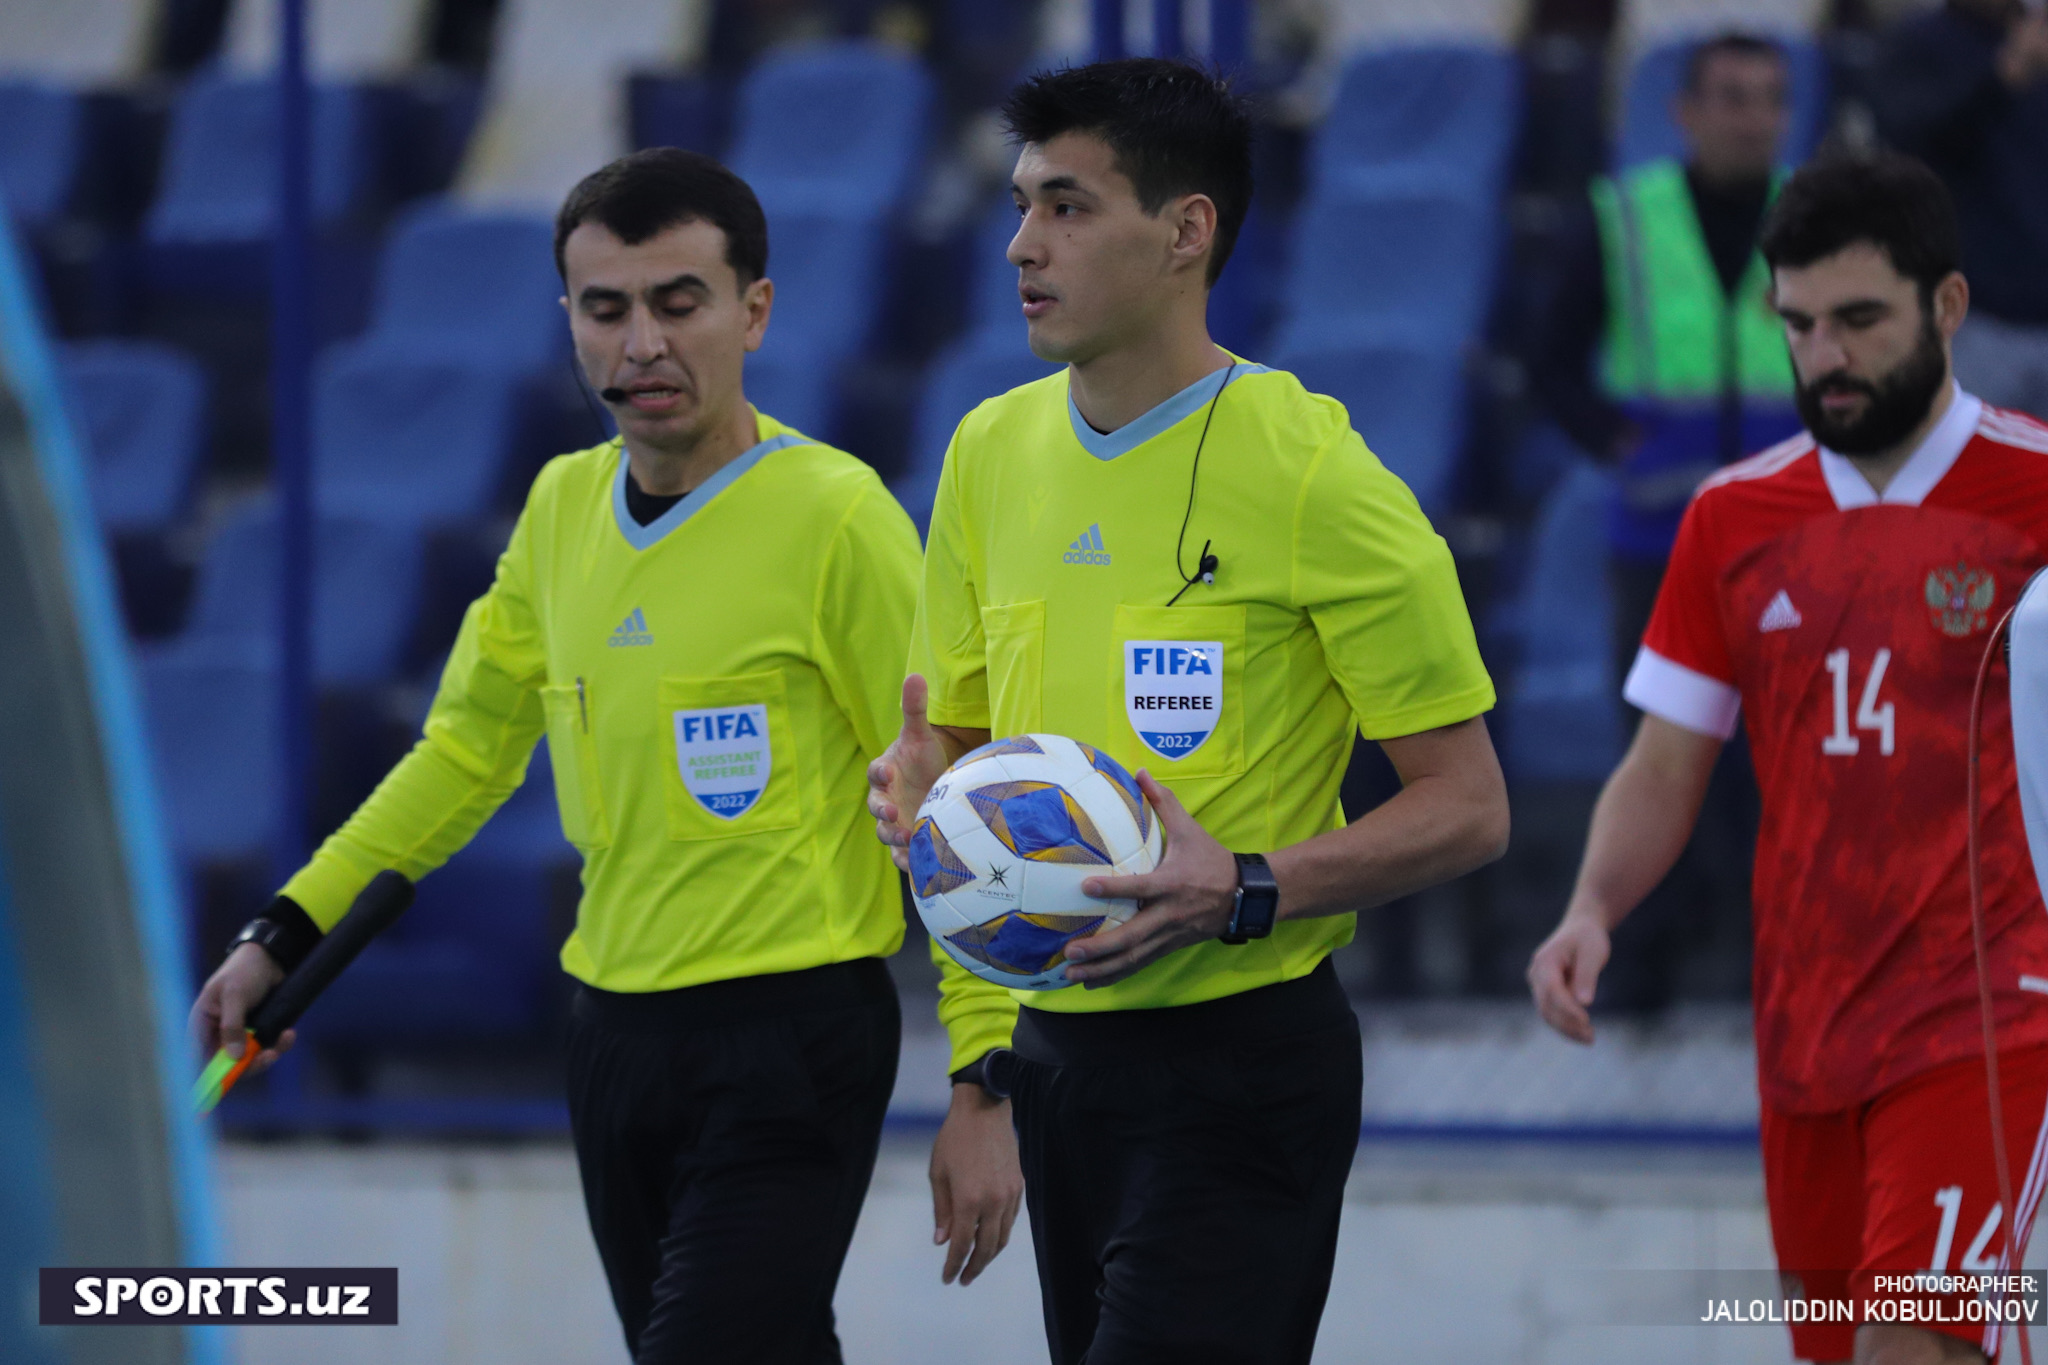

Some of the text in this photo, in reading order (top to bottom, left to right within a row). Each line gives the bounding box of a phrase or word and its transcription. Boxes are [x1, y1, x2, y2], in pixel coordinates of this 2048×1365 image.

[1063, 548, 1111, 566] adidas
[608, 634, 654, 648] adidas
[1133, 648, 1213, 675] FIFA
[1134, 696, 1213, 710] REFEREE
[1822, 647, 1895, 756] 14
[683, 713, 758, 743] FIFA
[1156, 735, 1193, 749] 2022
[688, 750, 761, 768] ASSISTANT
[694, 766, 756, 780] REFEREE
[712, 795, 746, 810] 2022
[976, 889, 1016, 899] ACENTEC
